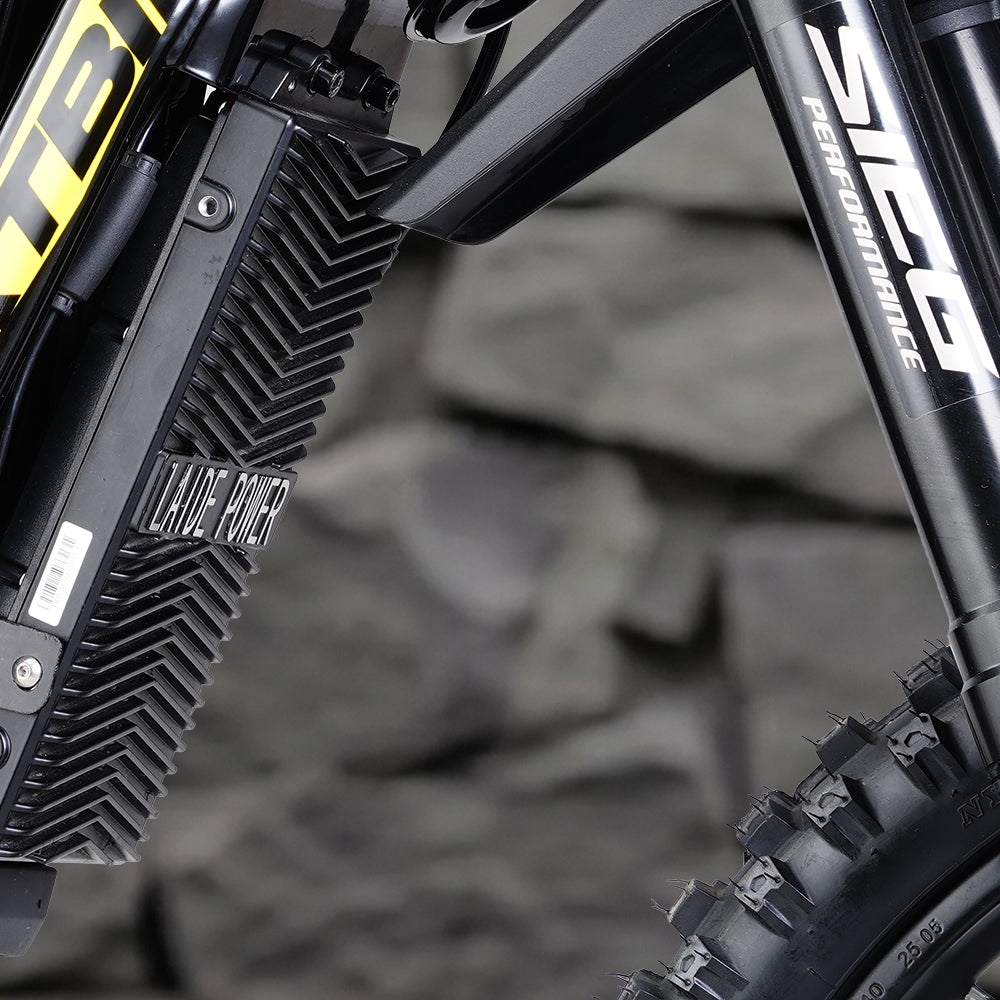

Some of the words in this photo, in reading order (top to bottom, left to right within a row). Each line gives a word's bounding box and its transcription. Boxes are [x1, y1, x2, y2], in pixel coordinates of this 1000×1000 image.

[801, 96, 927, 373] PERFORMANCE
[804, 24, 1000, 378] SIEG
[213, 471, 291, 546] POWER
